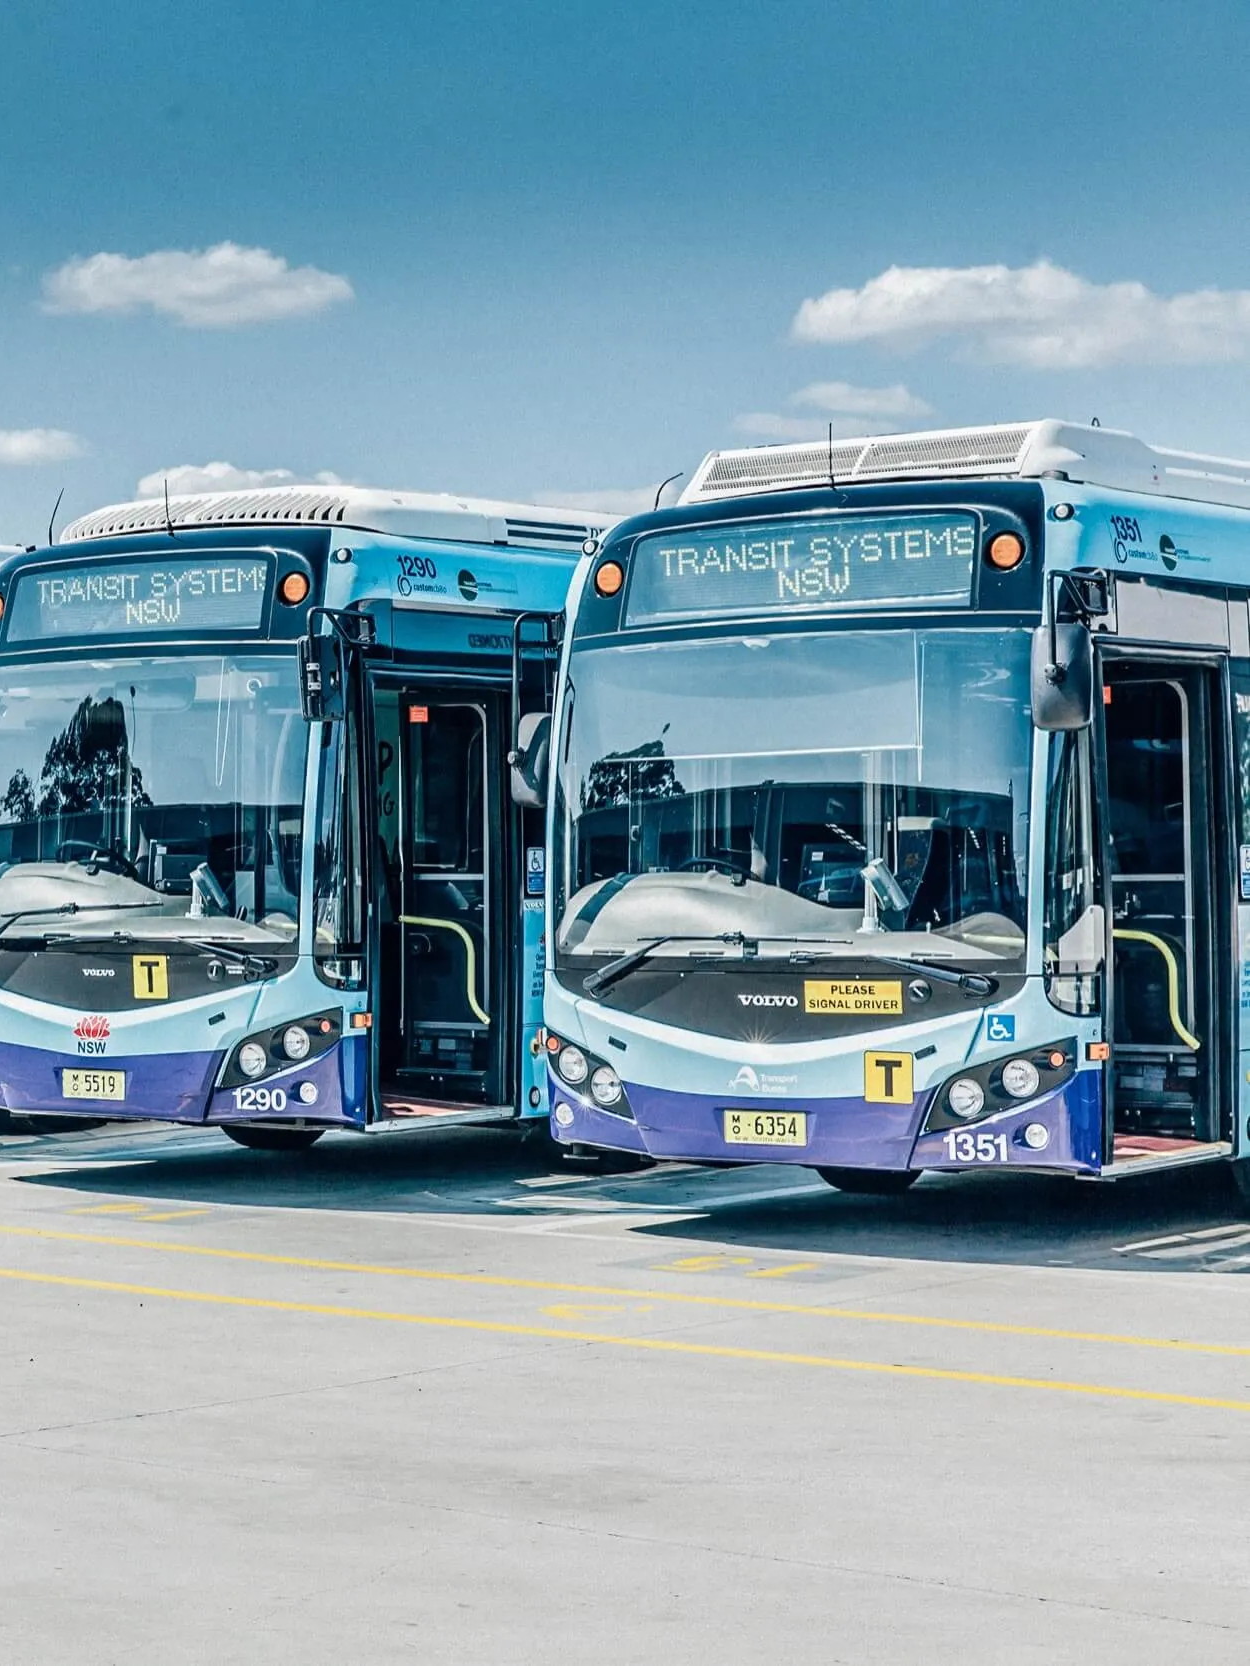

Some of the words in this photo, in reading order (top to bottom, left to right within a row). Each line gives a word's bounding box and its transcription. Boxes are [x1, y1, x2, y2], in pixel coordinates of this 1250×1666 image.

[1111, 515, 1142, 542] 1351
[659, 540, 795, 576] TRANSIT
[810, 525, 974, 566] SYSTEMS
[397, 555, 437, 578] 1290
[37, 574, 140, 604] TRANSIT
[777, 566, 851, 598] NSW
[126, 599, 181, 624] NSW
[82, 969, 115, 977] VOLVO
[140, 961, 159, 993] T
[738, 994, 798, 1007] VOLVO
[831, 985, 875, 995] PLEASE
[809, 999, 850, 1009] SIGNAL
[855, 1000, 898, 1009] DRIVER
[77, 1042, 106, 1054] NSW
[85, 1074, 115, 1092] 5519
[875, 1059, 902, 1097] T
[232, 1088, 287, 1111] 1290
[755, 1116, 797, 1136] 6354
[942, 1133, 1008, 1163] 1351
